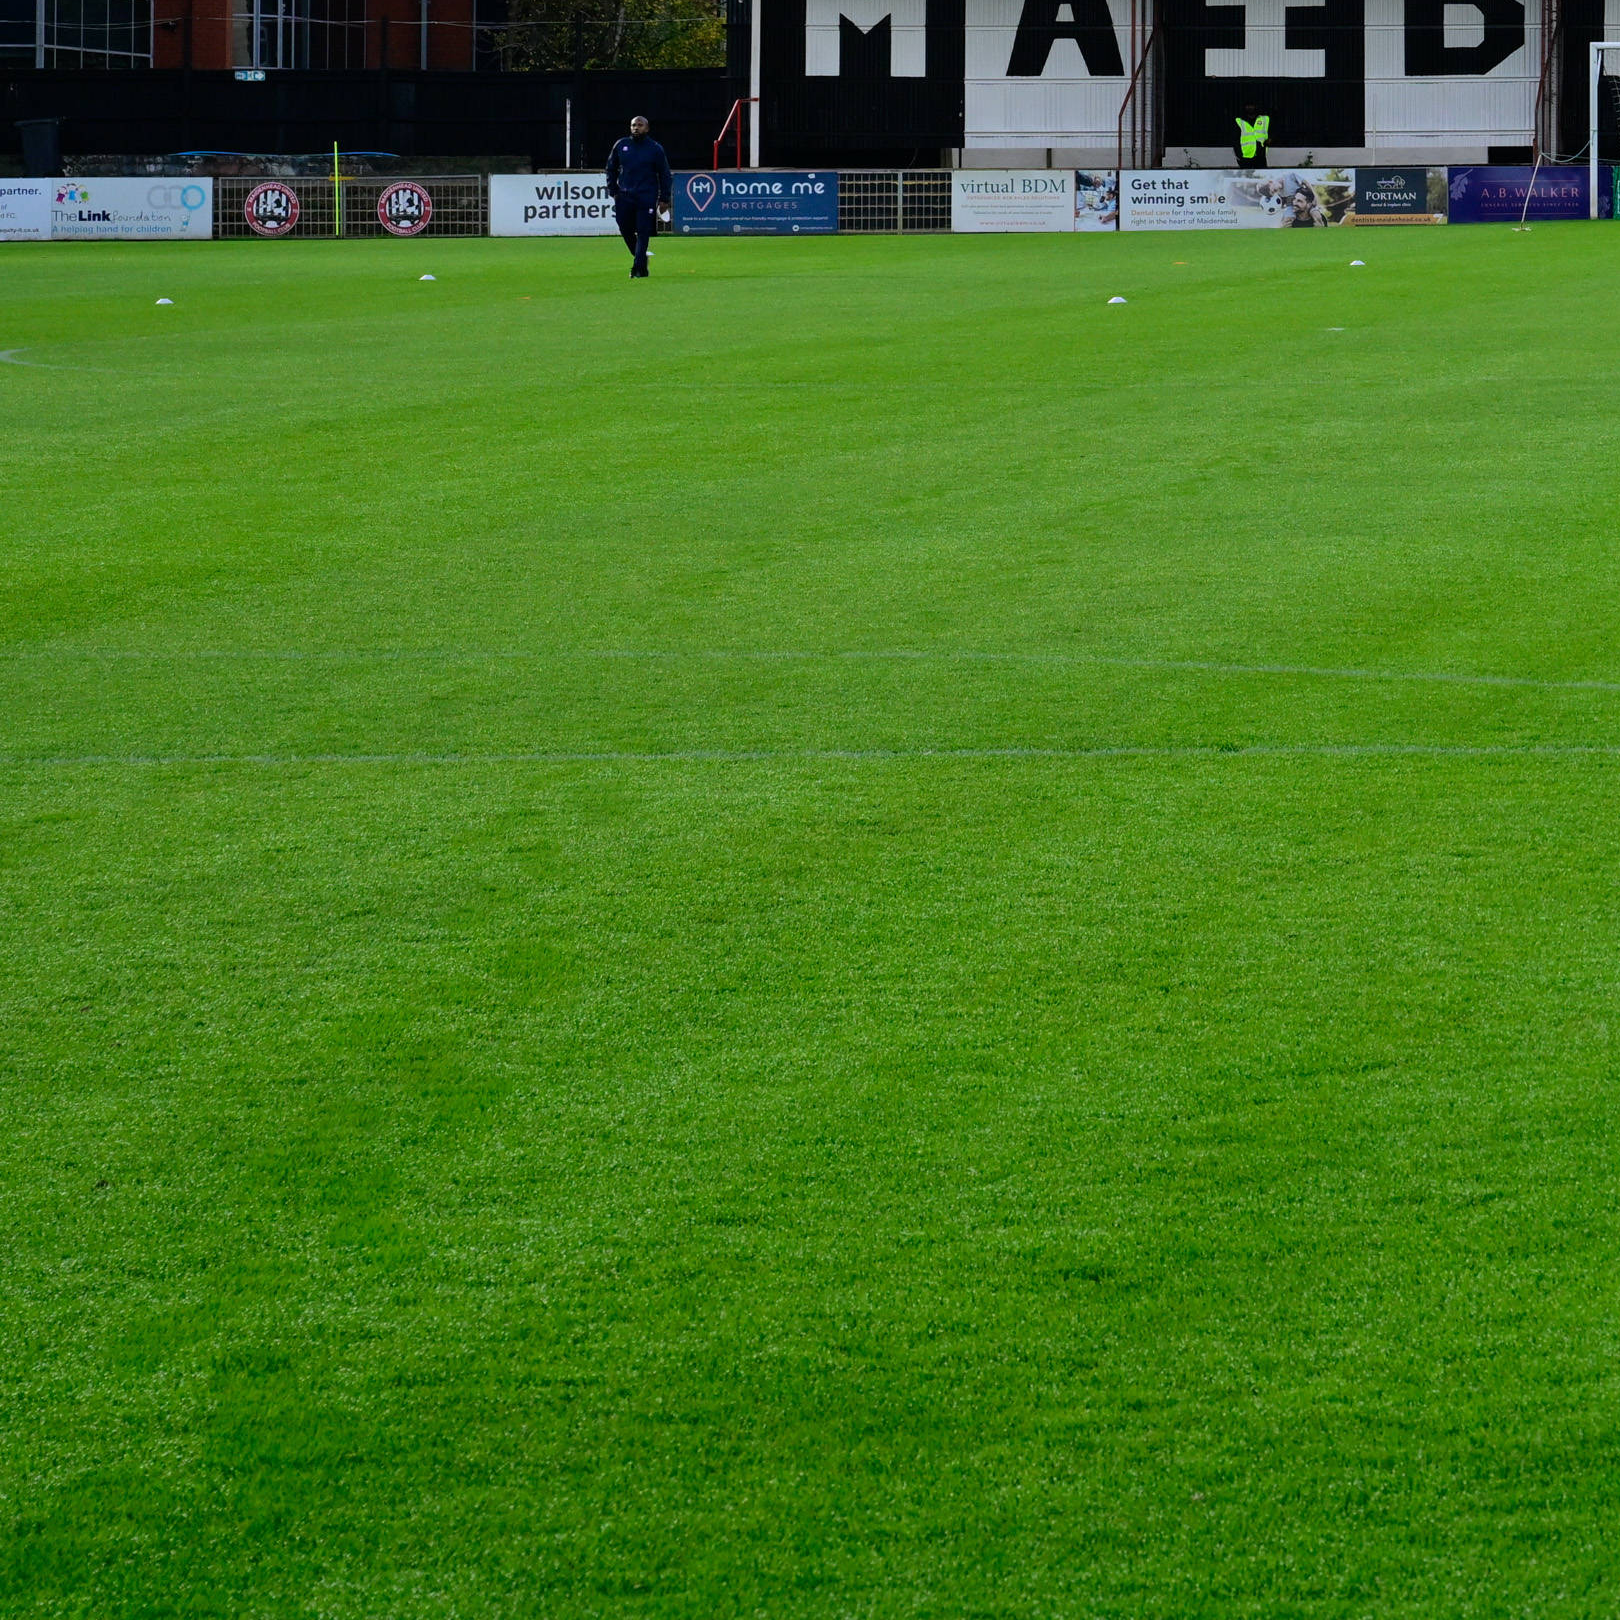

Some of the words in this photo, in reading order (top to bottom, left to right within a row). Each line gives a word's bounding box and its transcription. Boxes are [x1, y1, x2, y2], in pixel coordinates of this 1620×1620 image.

[535, 180, 609, 200] wilson
[722, 178, 783, 195] home
[791, 182, 825, 195] me
[960, 178, 1015, 194] virtual
[1022, 178, 1066, 194] BDM
[1131, 179, 1157, 190] Get
[1161, 178, 1189, 190] that
[1131, 193, 1185, 207] winning
[1189, 193, 1226, 204] smile
[1366, 191, 1417, 200] PORTMAN
[722, 201, 798, 210] MORTGAGES
[1217, 208, 1237, 216] family
[61, 225, 93, 234] helping
